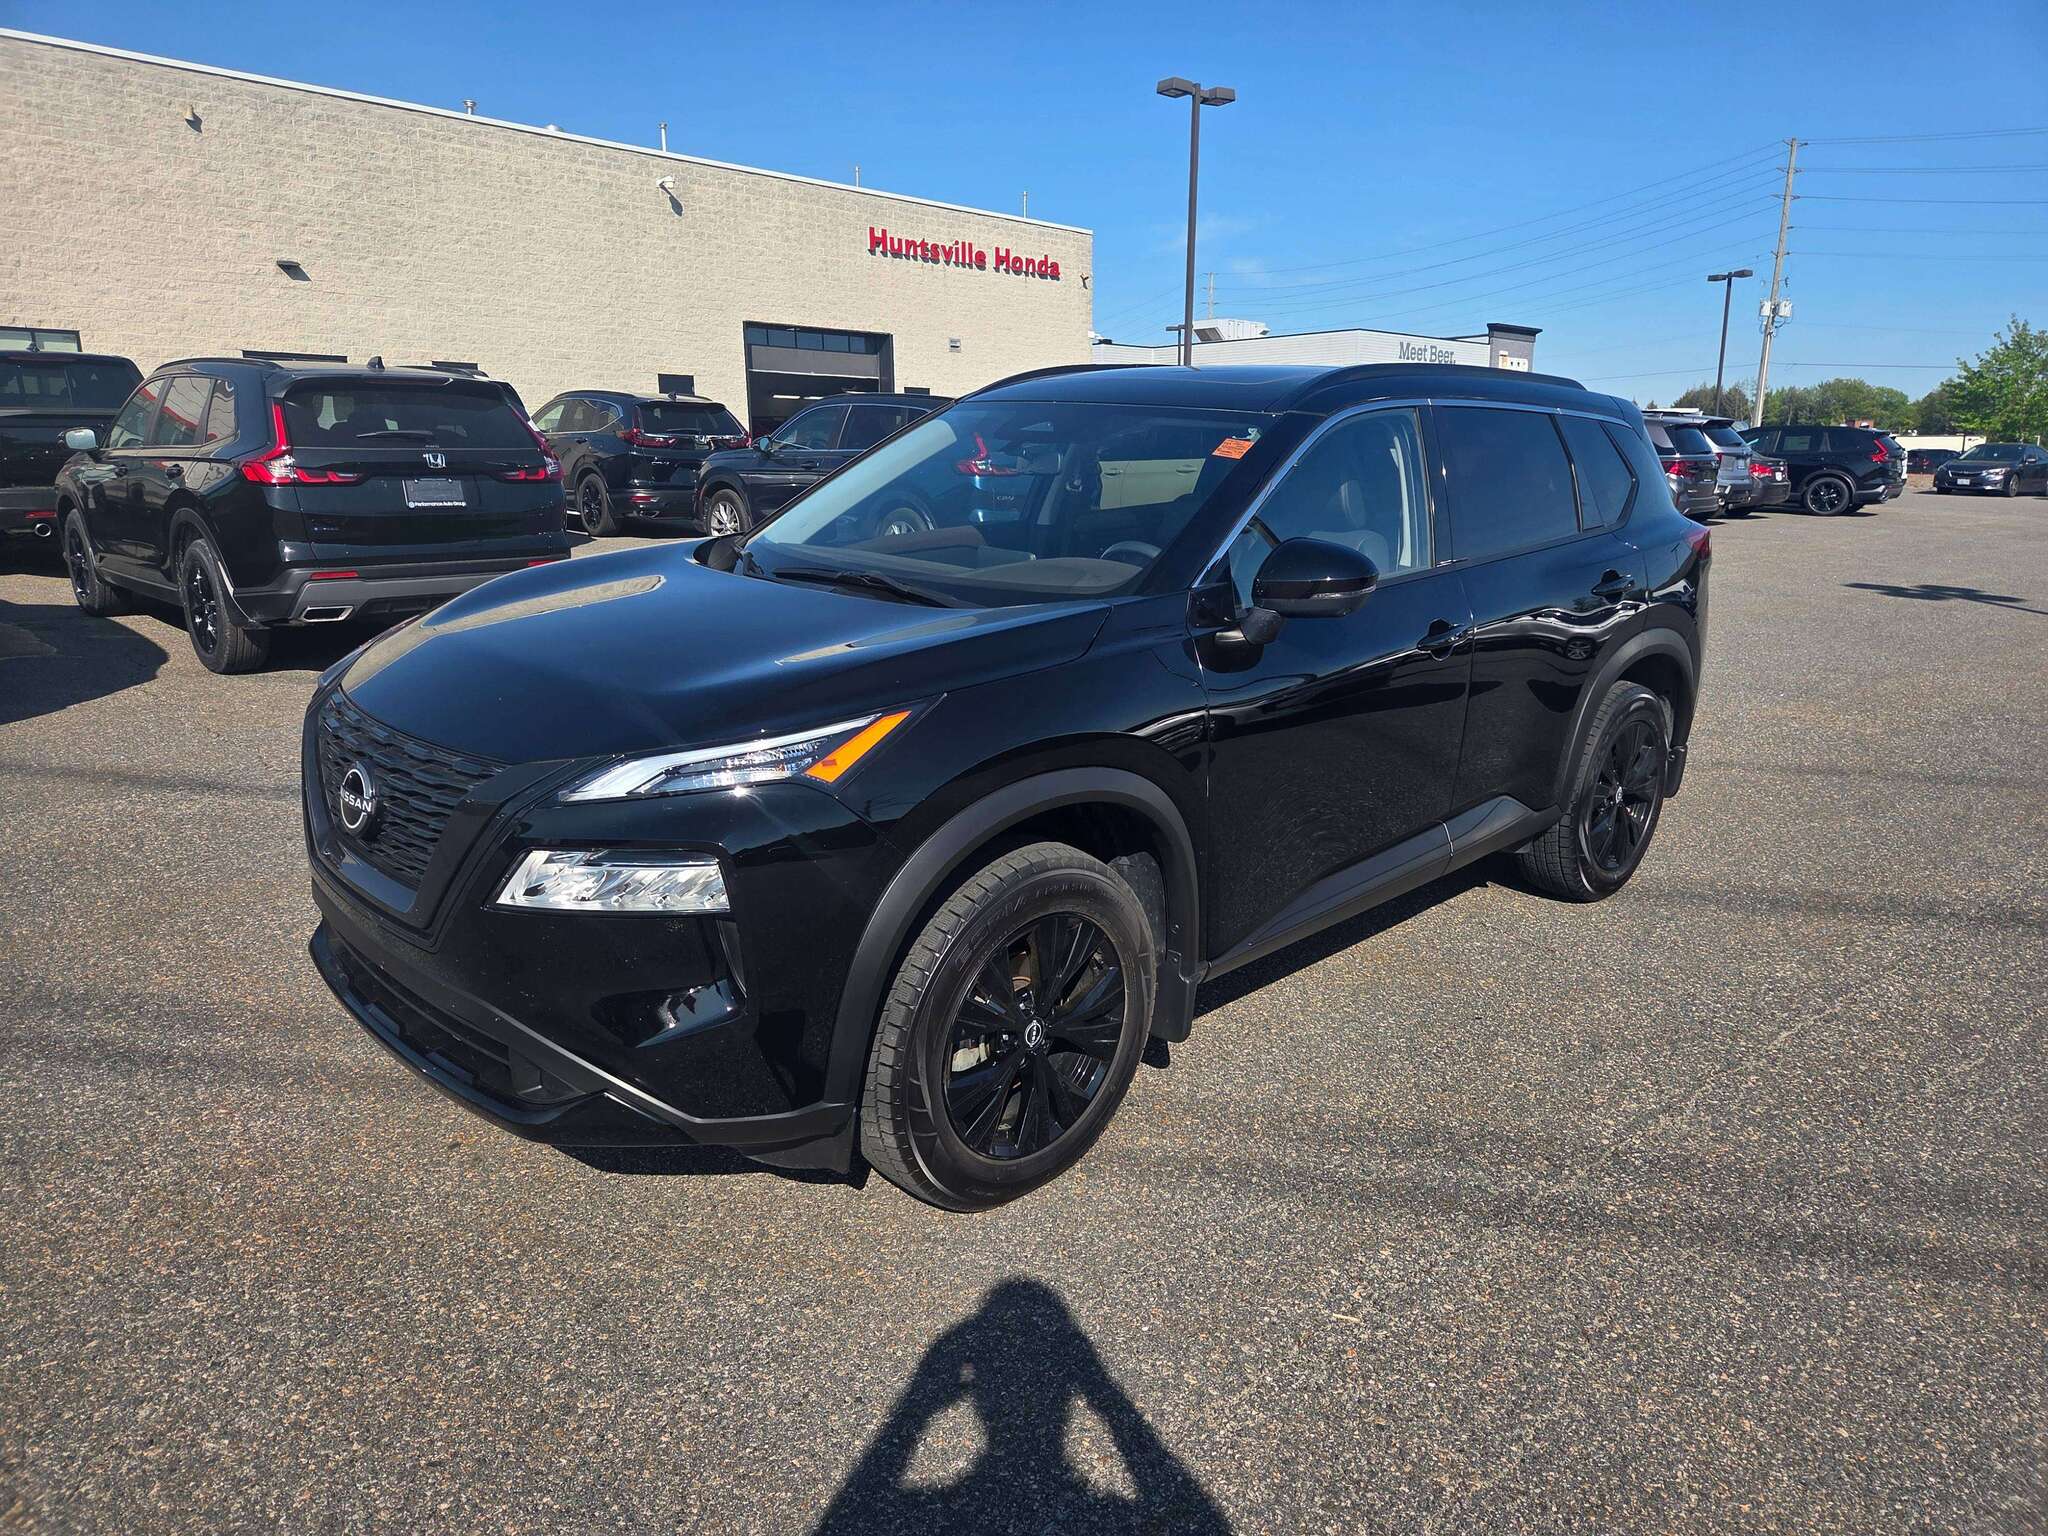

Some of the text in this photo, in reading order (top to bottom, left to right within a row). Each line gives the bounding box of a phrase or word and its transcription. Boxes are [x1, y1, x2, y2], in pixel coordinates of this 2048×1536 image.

[868, 226, 1060, 277] Huntsville Honda
[1398, 341, 1428, 362] Meet
